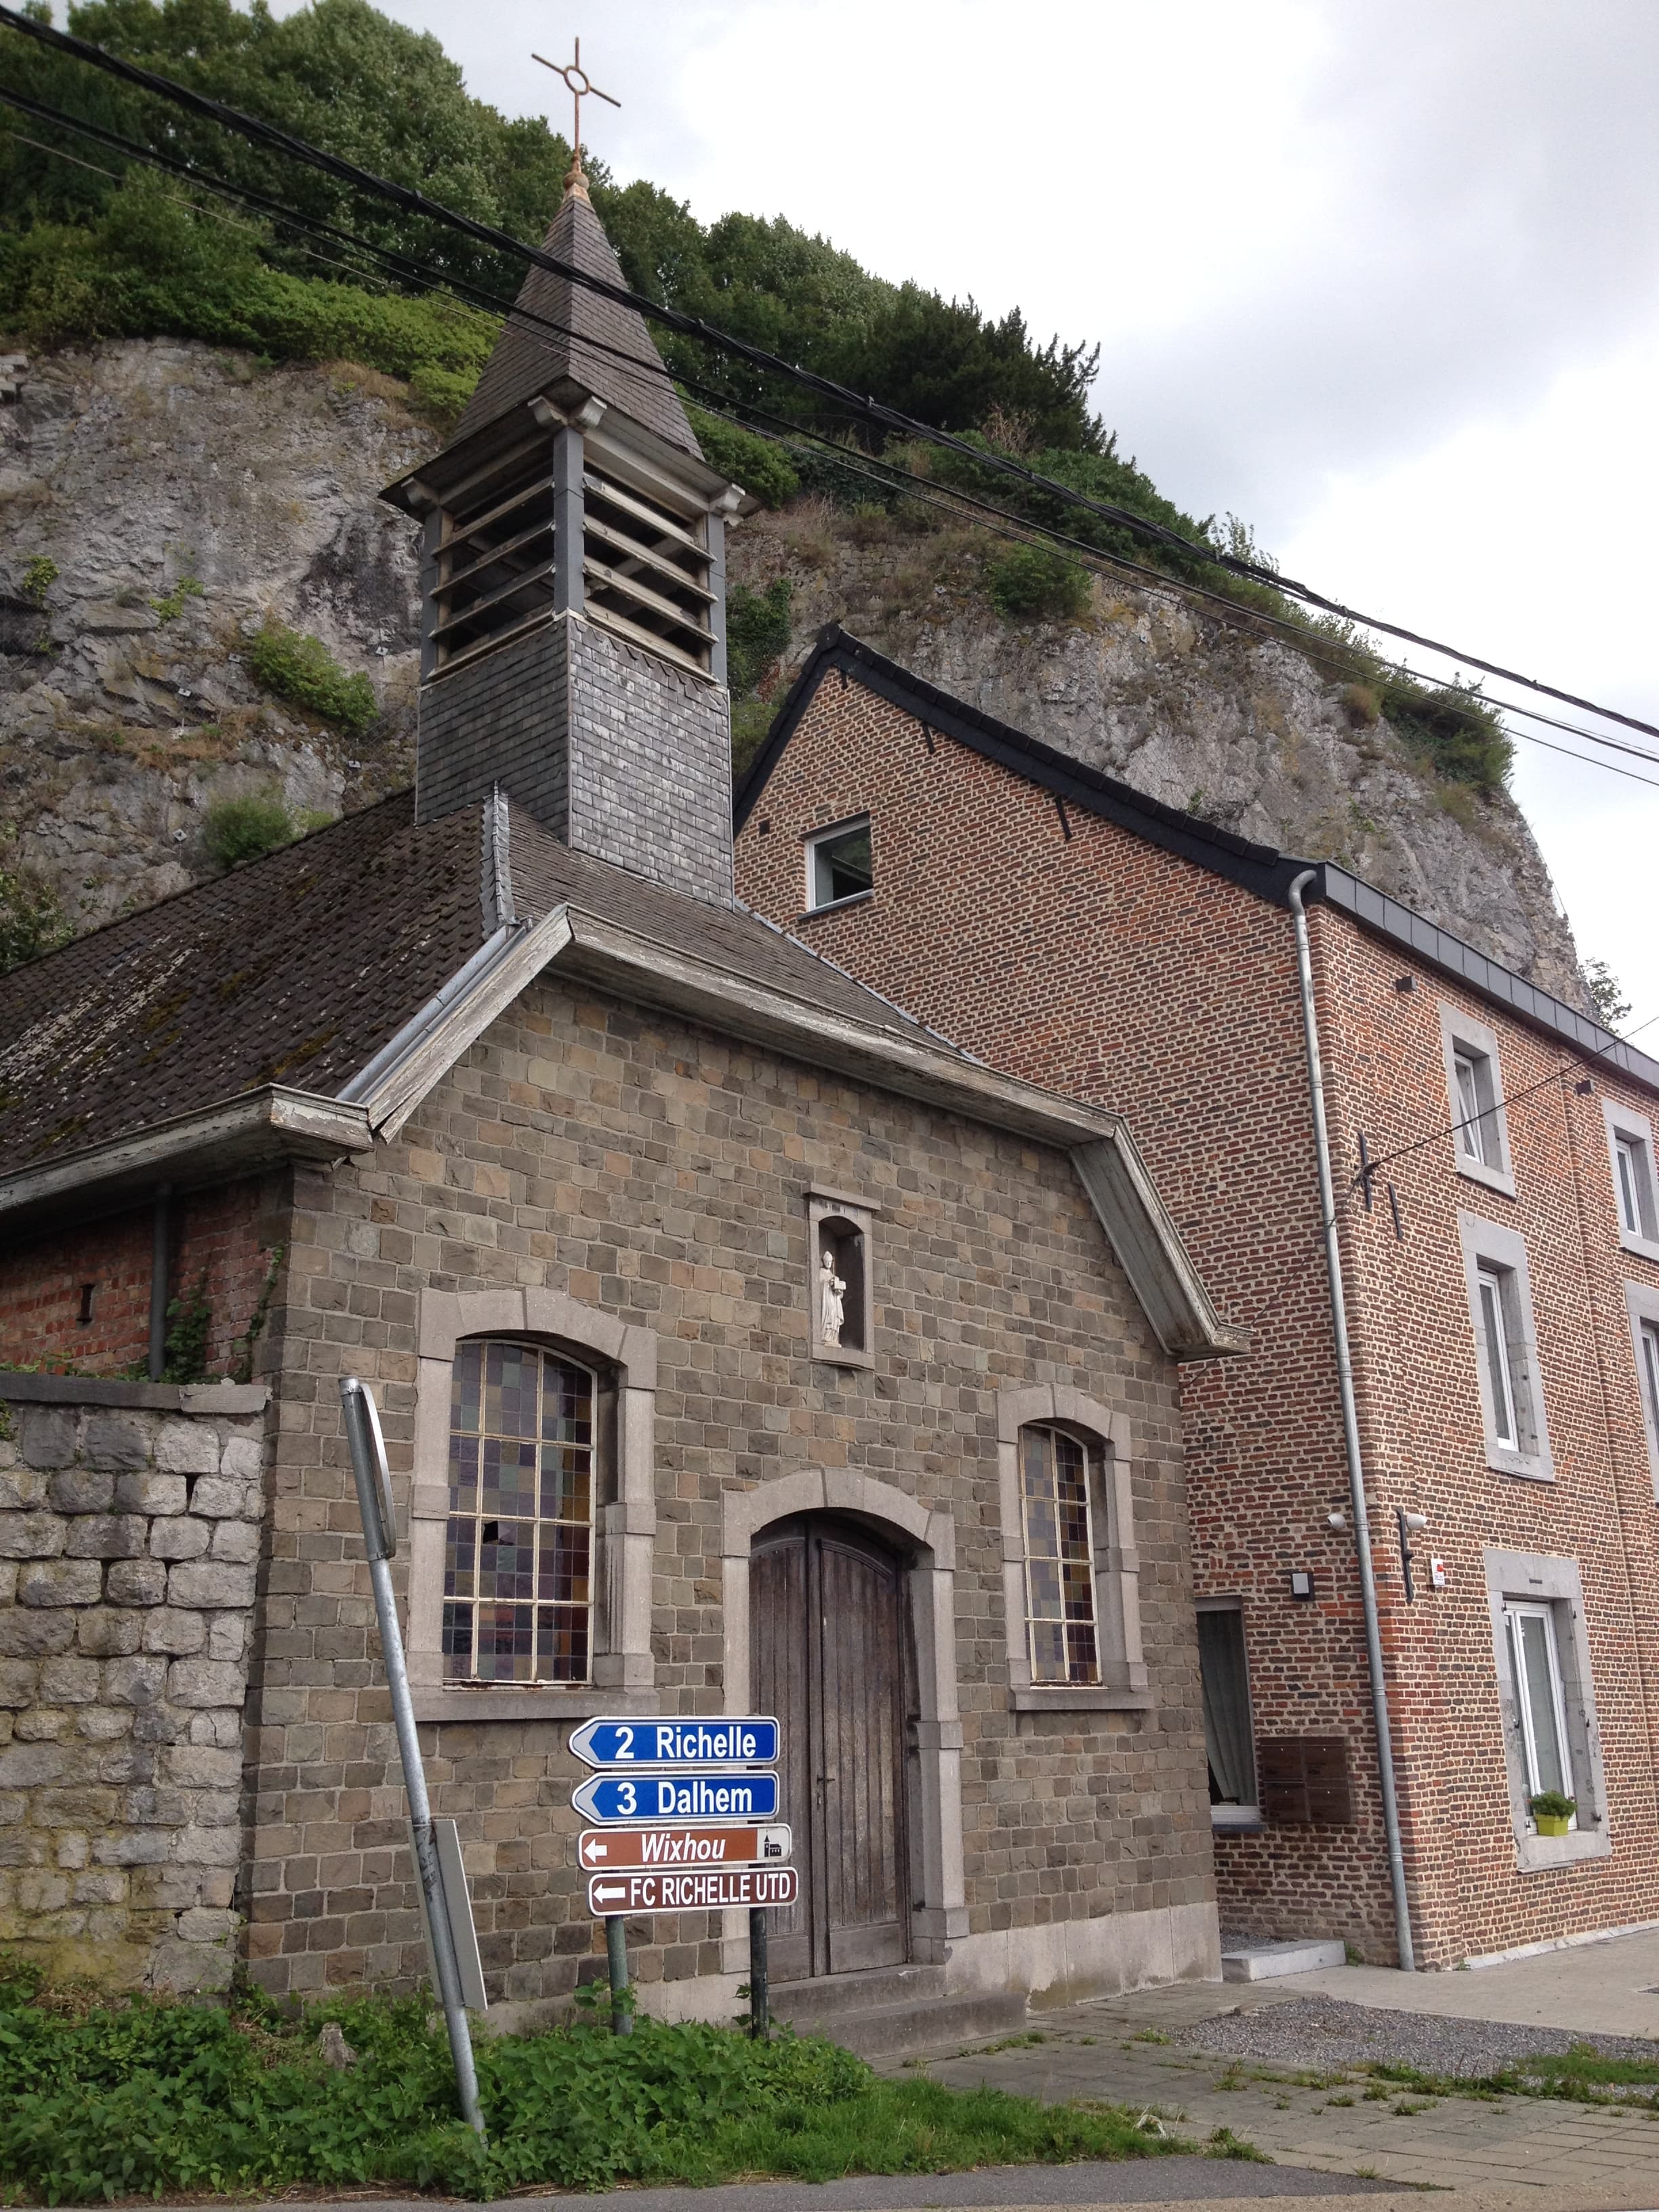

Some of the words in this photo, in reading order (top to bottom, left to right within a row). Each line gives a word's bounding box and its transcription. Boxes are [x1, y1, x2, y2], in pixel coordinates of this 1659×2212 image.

[615, 1726, 634, 1759] 2
[657, 1726, 756, 1759] Richelle
[617, 1782, 637, 1815] 3
[658, 1781, 752, 1814] Dalhem
[641, 1832, 726, 1862] Wixhou
[630, 1878, 656, 1906] FC
[662, 1875, 751, 1905] RICHELLE
[756, 1872, 790, 1901] UTD
